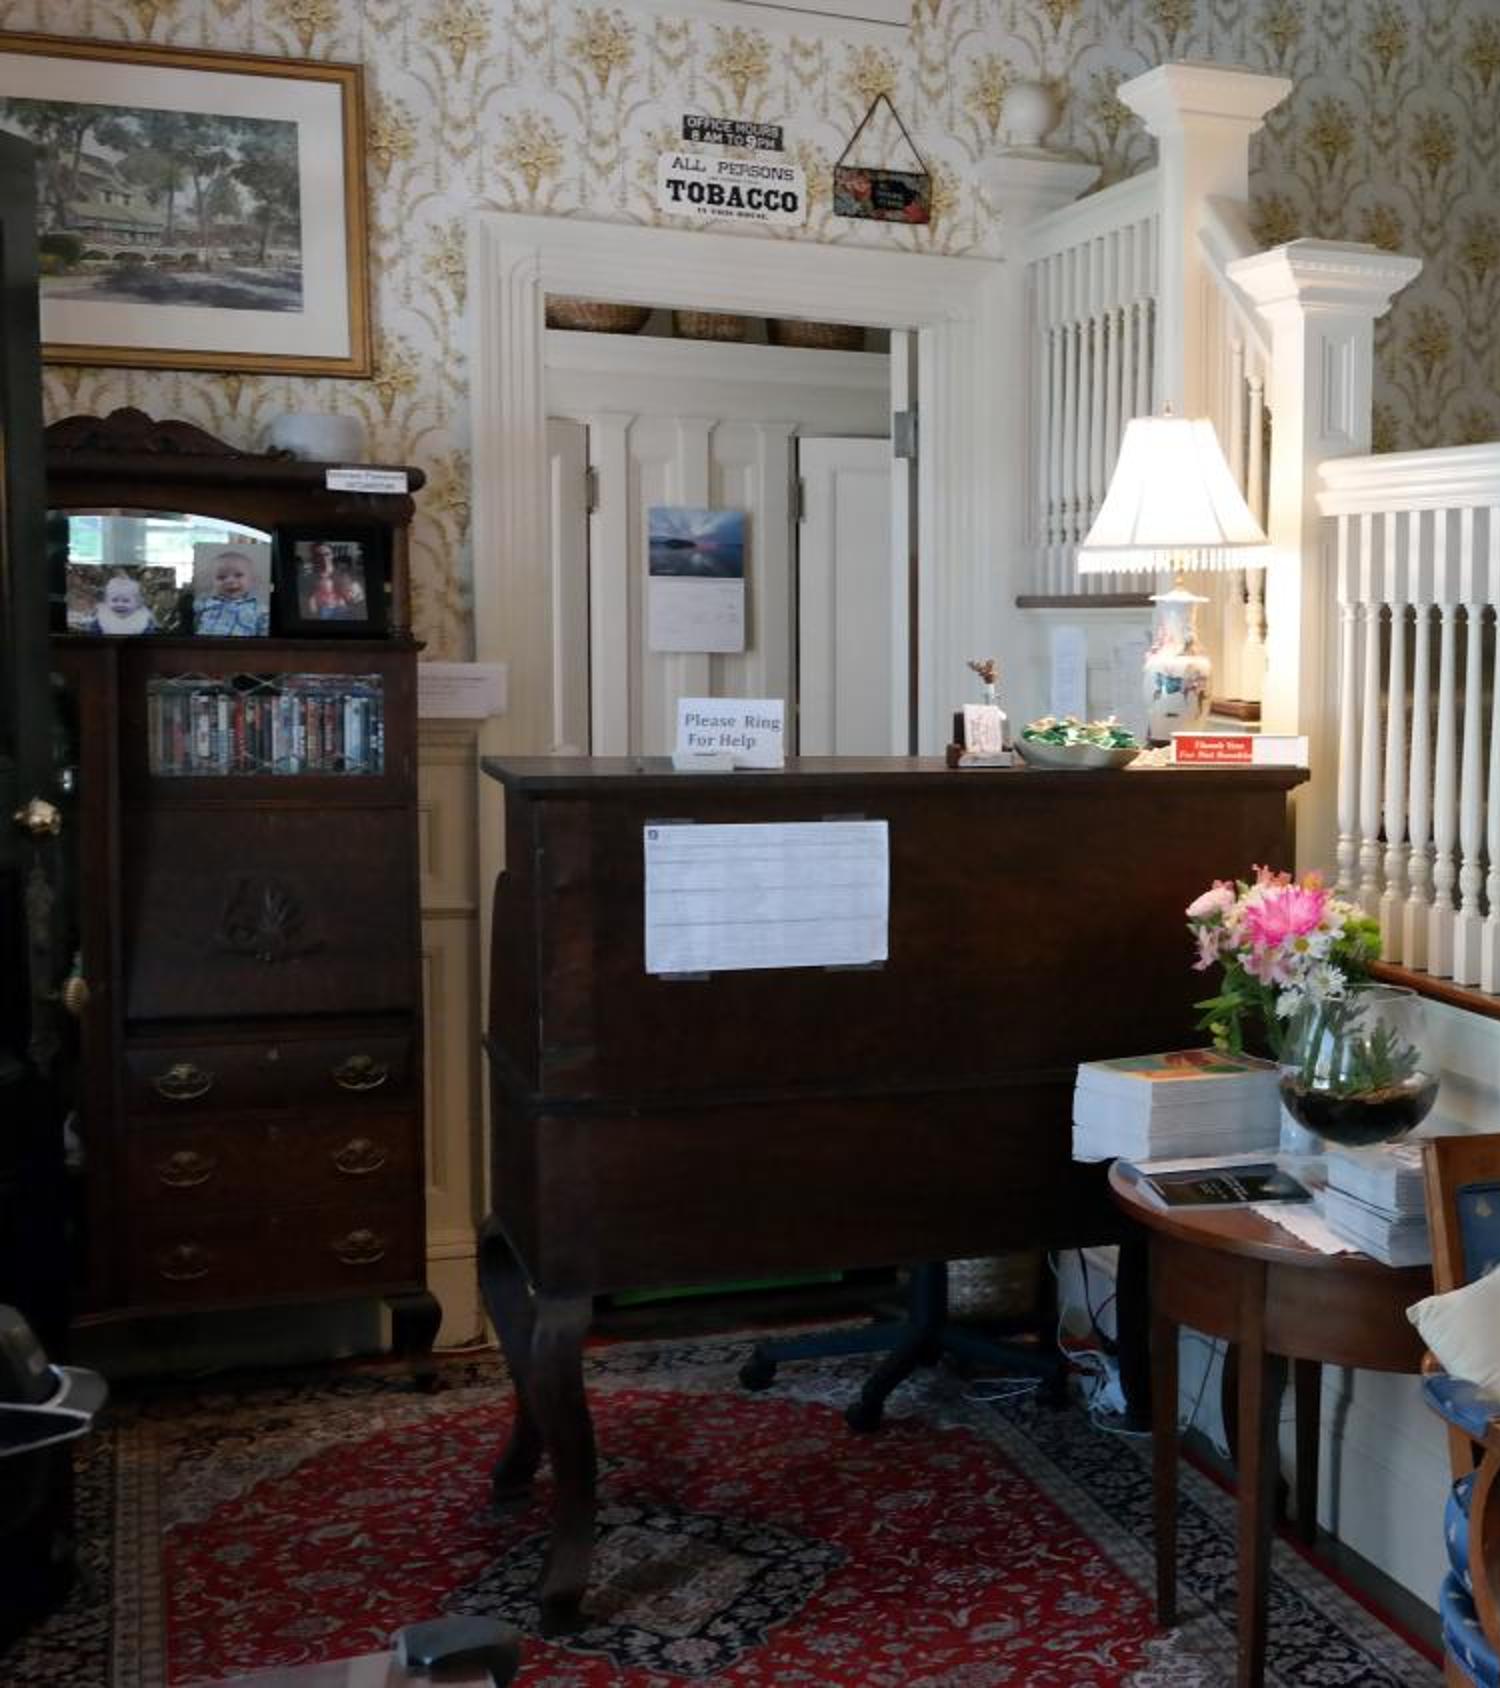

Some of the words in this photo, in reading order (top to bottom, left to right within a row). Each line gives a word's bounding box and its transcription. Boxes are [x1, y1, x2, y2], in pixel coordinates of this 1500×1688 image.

[687, 117, 734, 133] OFFICE
[735, 123, 779, 138] HOURS
[691, 129, 699, 141] 8
[703, 131, 723, 144] AM
[727, 134, 744, 146] TO
[672, 156, 706, 173] ALL
[718, 161, 795, 181] PERSONS
[666, 178, 799, 213] TOBACCO
[685, 713, 737, 727] Please
[744, 714, 781, 732] Ring
[687, 733, 717, 745] For
[719, 733, 756, 750] Help
[1194, 740, 1225, 750] Thank
[1226, 740, 1245, 750] You
[1178, 751, 1195, 759] For
[1198, 751, 1215, 759] Not
